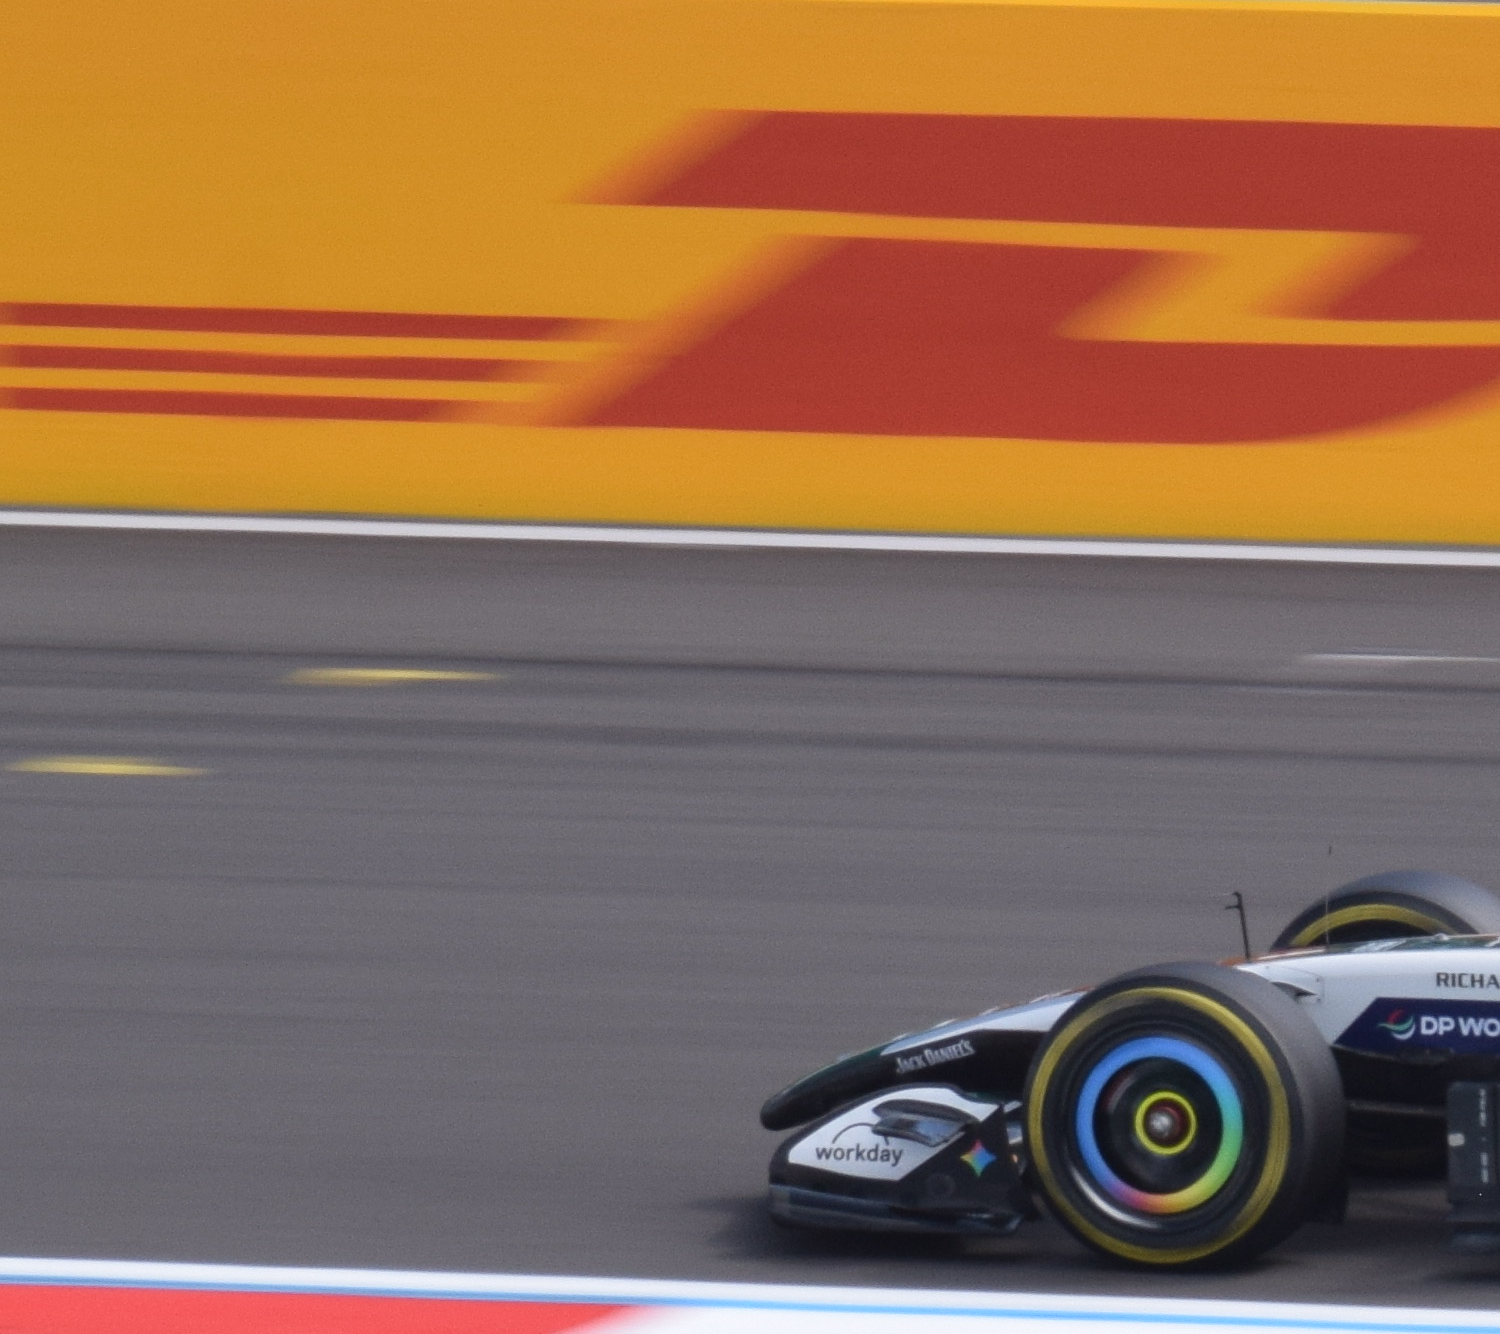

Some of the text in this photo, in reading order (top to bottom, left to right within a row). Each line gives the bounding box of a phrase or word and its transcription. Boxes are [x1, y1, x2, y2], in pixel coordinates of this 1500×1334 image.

[1421, 1016, 1455, 1036] DP
[896, 1055, 927, 1074] JACK
[815, 1142, 903, 1166] workday
